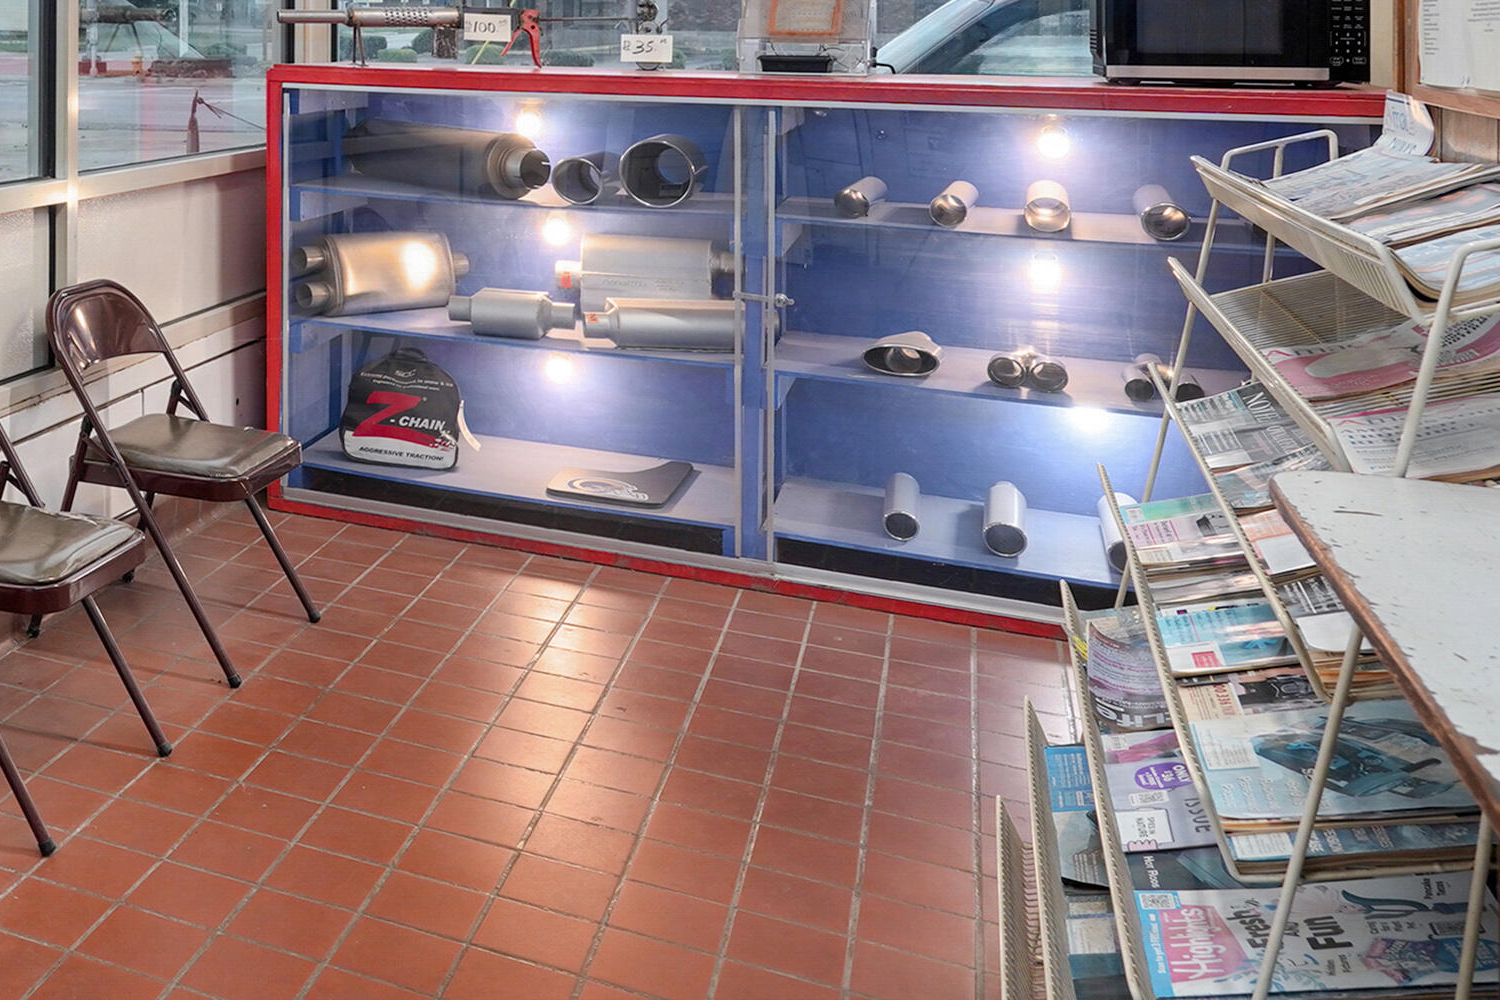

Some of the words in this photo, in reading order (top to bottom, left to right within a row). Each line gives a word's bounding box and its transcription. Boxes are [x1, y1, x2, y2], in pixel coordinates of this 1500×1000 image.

[358, 446, 405, 458] AGGRESSIVE
[406, 451, 444, 461] TRACTION!
[1168, 907, 1227, 980] Highlights
[1303, 915, 1353, 951] Fun
